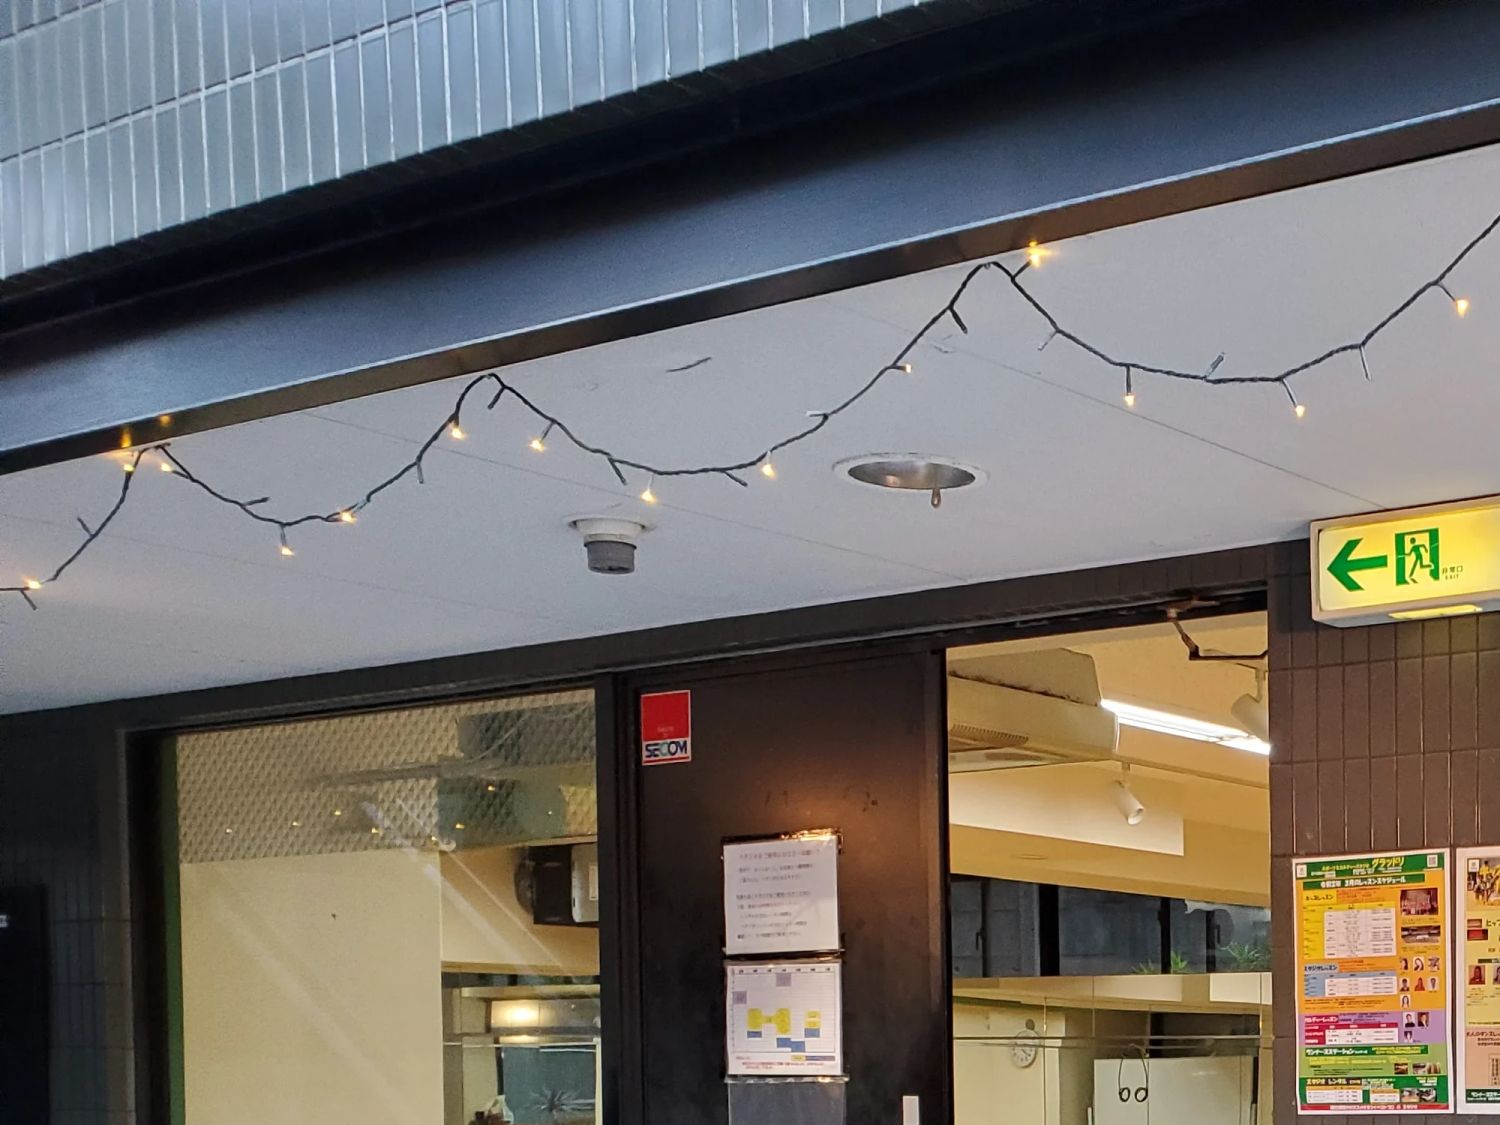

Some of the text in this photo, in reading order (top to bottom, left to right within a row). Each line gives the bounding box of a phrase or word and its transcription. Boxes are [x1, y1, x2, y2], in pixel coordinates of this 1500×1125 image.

[1442, 565, 1464, 575] 非常口
[645, 740, 688, 758] SECOM
